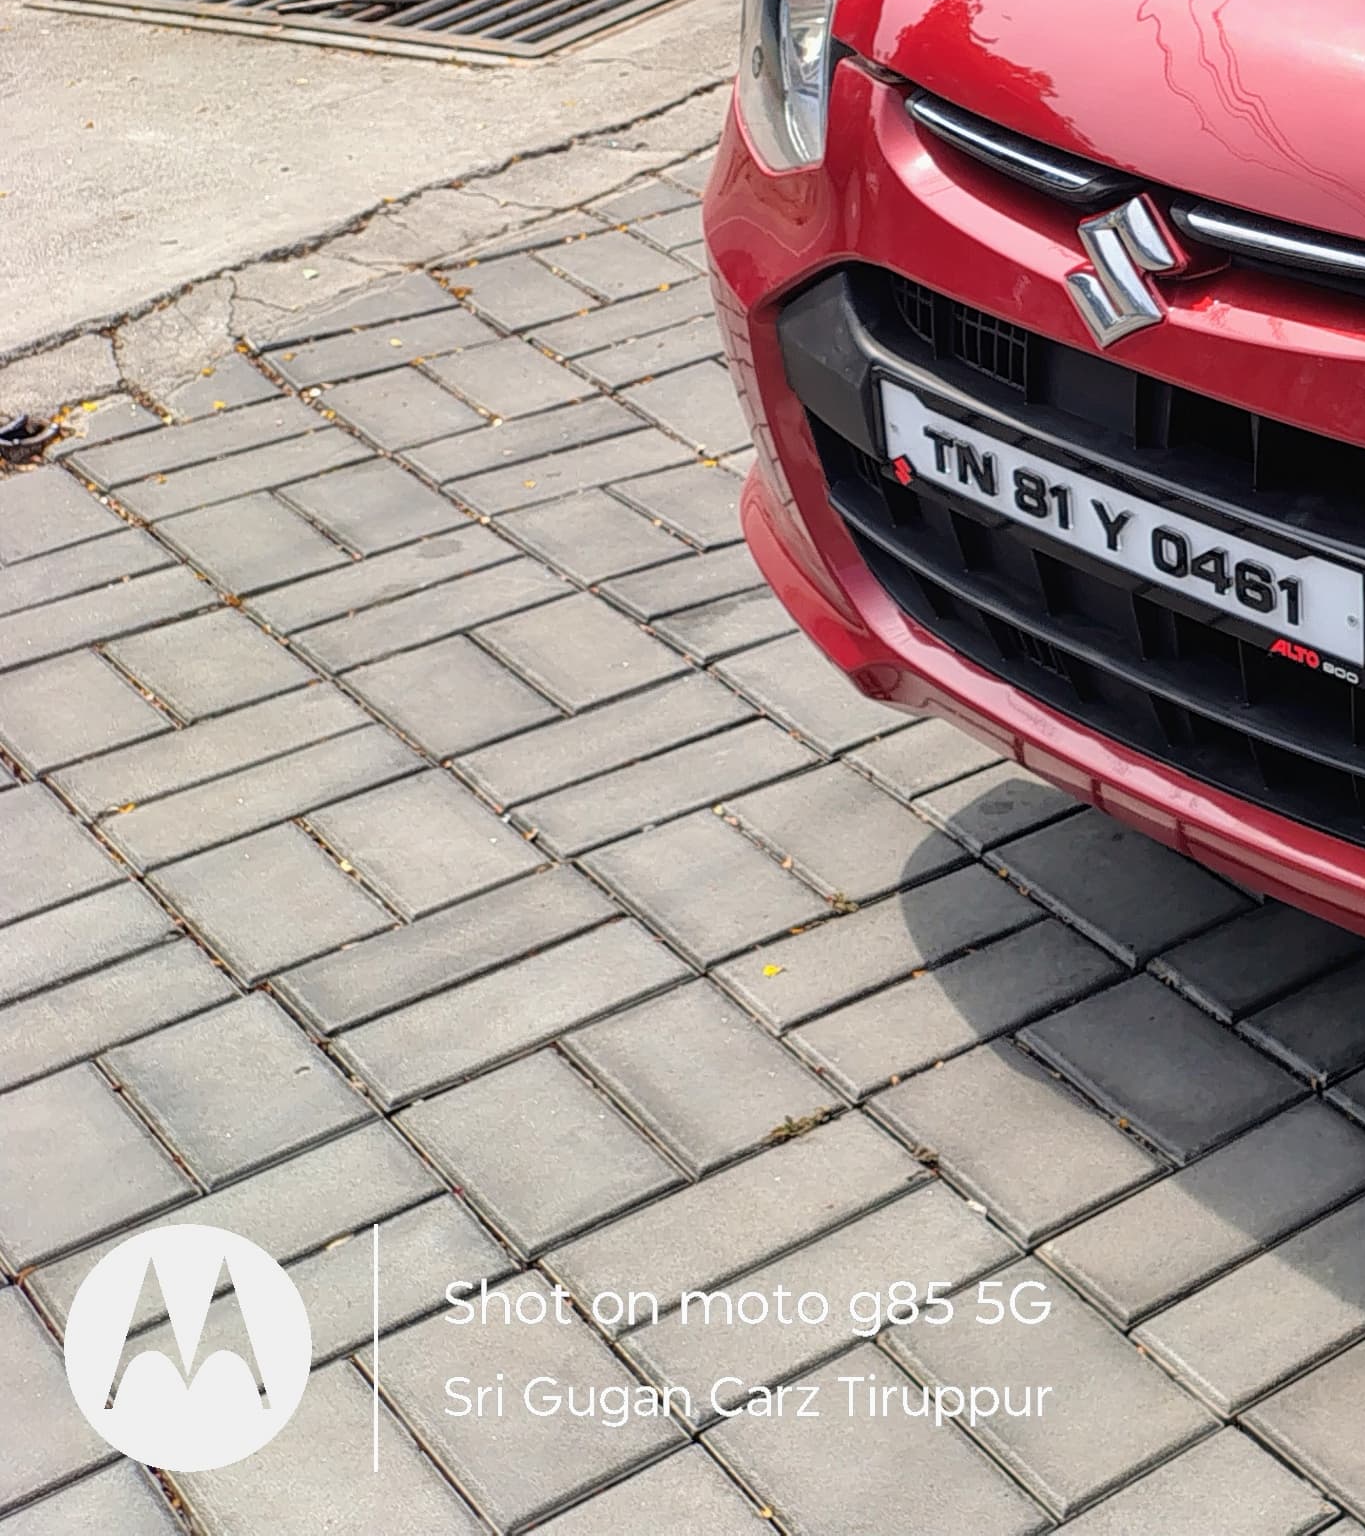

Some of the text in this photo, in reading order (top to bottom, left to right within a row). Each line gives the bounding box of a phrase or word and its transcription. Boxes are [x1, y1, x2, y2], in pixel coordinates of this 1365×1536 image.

[924, 425, 1305, 626] TN 81 Y 0461
[1269, 638, 1360, 685] ALTO 800
